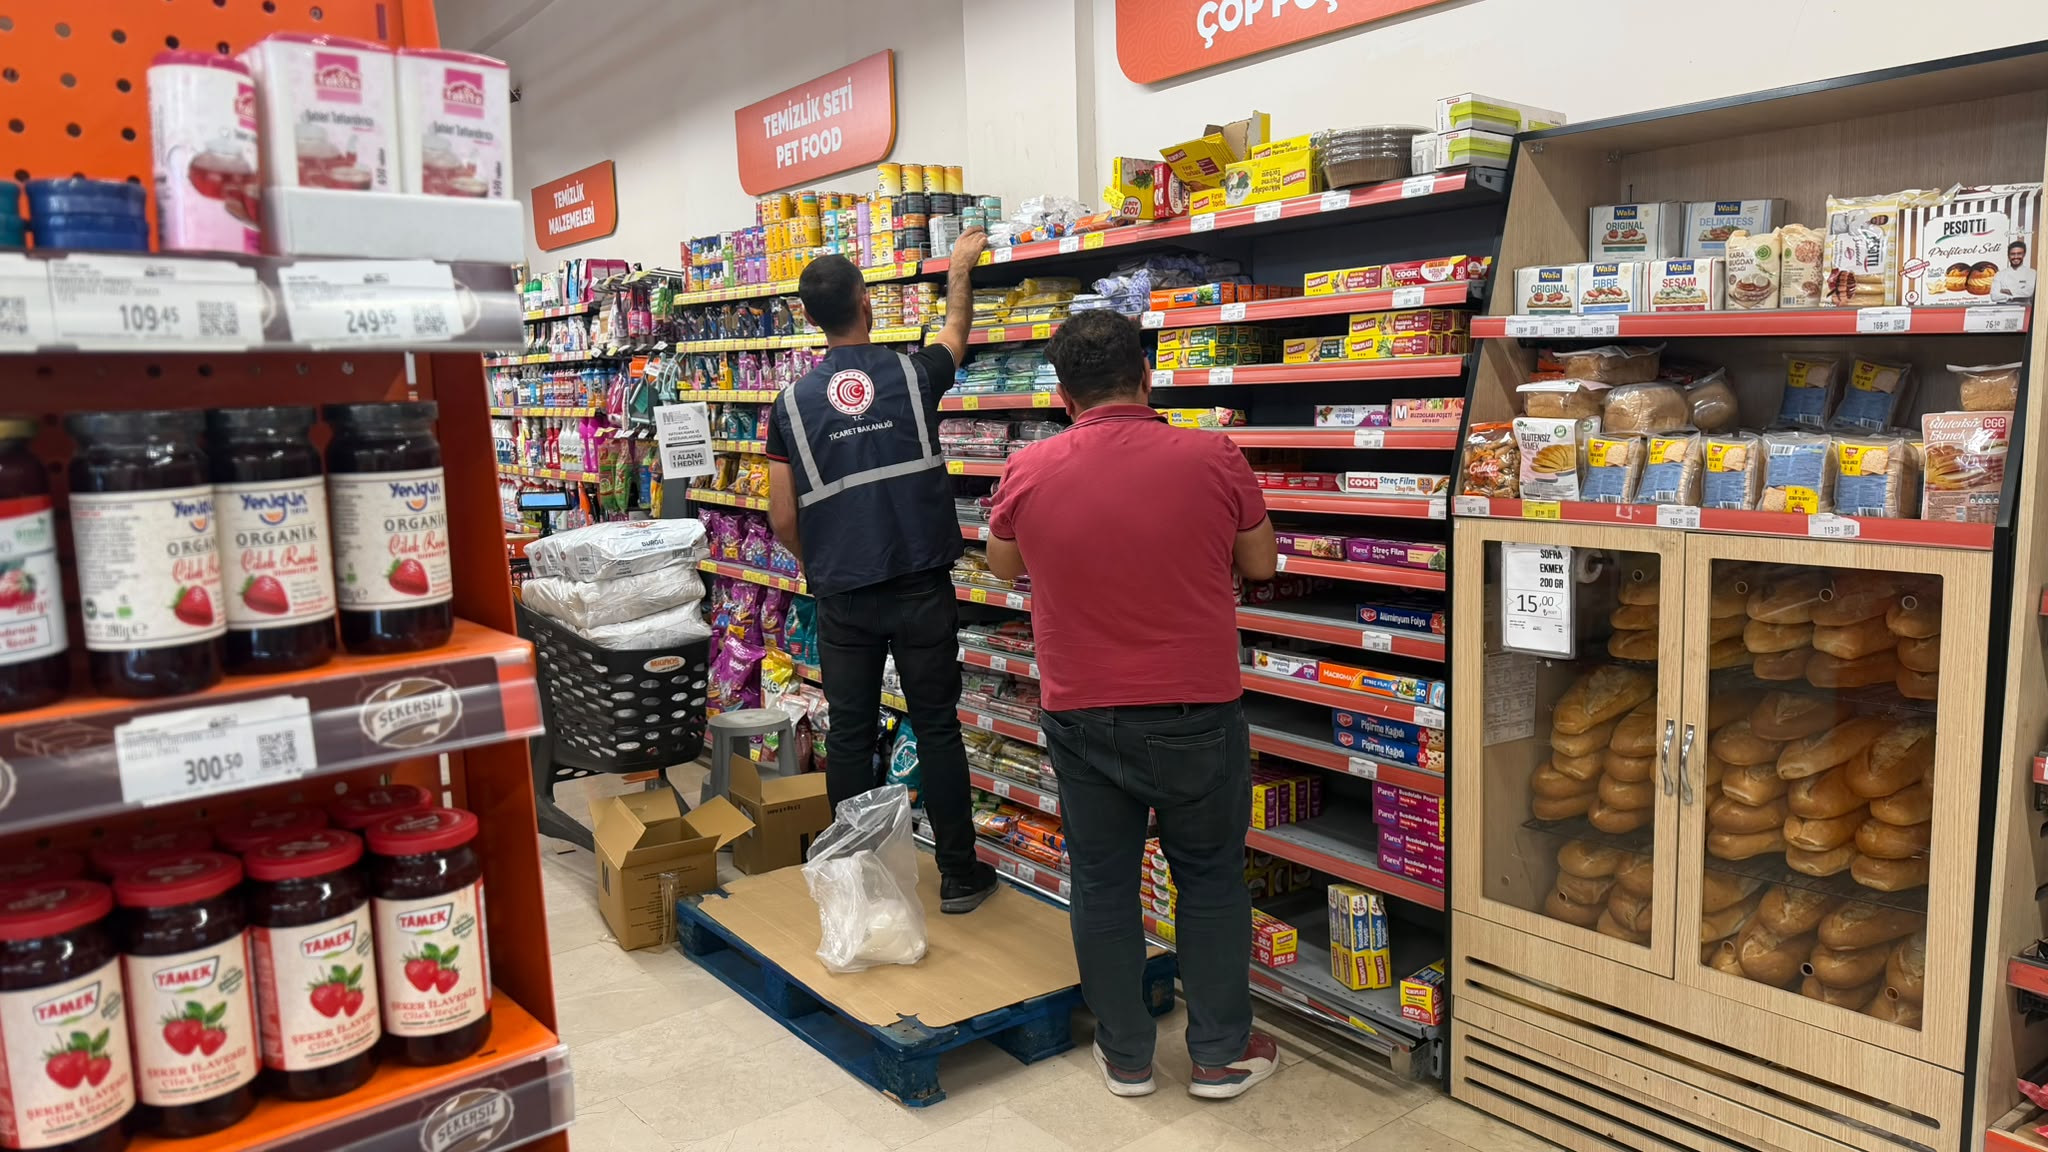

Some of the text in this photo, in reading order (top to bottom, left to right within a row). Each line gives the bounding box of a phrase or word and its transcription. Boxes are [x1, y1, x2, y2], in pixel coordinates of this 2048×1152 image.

[763, 76, 853, 139] TEMİZLİK SETİ
[776, 126, 842, 169] PET FOOD
[553, 179, 586, 209] TEMİZLİK
[548, 200, 596, 236] MALZEMELERİ
[1700, 217, 1754, 226] DELIKATESS
[1605, 222, 1645, 230] ORIGINAL
[1396, 271, 1418, 279] COOK
[1456, 266, 1465, 274] 30
[1593, 278, 1618, 288] FIBRE
[1662, 277, 1697, 287] SESAM
[1531, 284, 1570, 293] ORIGINAL
[1395, 405, 1407, 419] M
[828, 420, 893, 441] TİCARET BAKANLIĞI
[677, 452, 703, 460] ALANA
[677, 458, 704, 467] HEDİYE
[1349, 478, 1377, 487] COOK
[1379, 475, 1416, 487] Streç Film
[235, 525, 318, 548] ORGANİK
[1372, 546, 1405, 556] Streç Film
[1540, 549, 1563, 559] SOFRA
[1540, 564, 1564, 574] EKMEK
[1540, 578, 1564, 588] 200 GR
[1517, 594, 1554, 613] 15,00
[1380, 611, 1426, 628] Alüminyum Folyo
[1416, 688, 1426, 697] 50
[1361, 719, 1405, 738] Pişirme Kağıdı
[1361, 739, 1405, 759] Pişirme Kağıdı
[1377, 787, 1395, 797] Parex
[1378, 809, 1395, 819] Parex
[1384, 832, 1401, 844] Parex
[1383, 854, 1400, 865] Parex
[399, 910, 448, 928] TAMEK
[304, 929, 353, 953] TAMEK
[156, 964, 212, 986] TAMEK
[37, 991, 95, 1020] TAMEK
[1403, 1006, 1421, 1017] DEV
